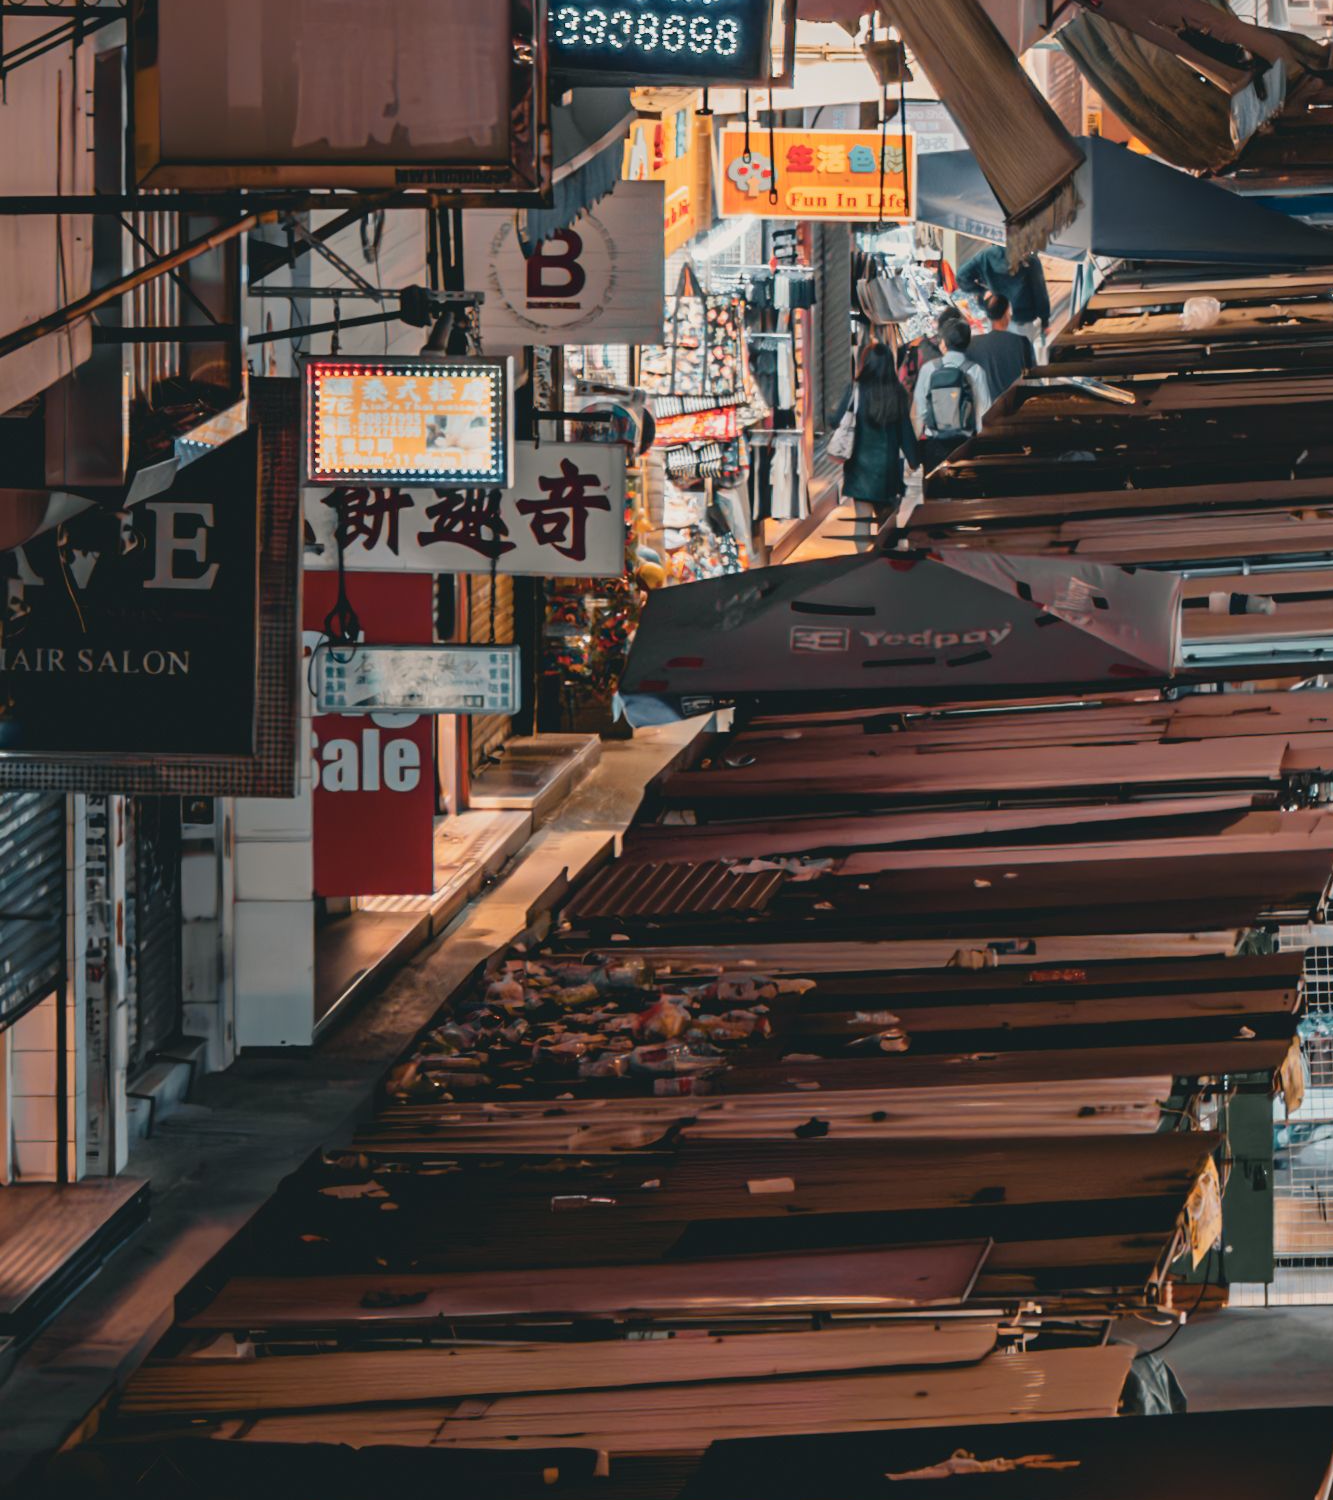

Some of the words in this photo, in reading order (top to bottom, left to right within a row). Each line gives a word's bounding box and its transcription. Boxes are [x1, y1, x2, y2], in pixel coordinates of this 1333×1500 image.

[790, 192, 827, 209] Fun
[837, 192, 858, 209] In
[866, 192, 907, 210] Life
[860, 622, 1011, 649] Yedpay
[77, 649, 190, 675] SALON
[311, 728, 420, 792] ale
